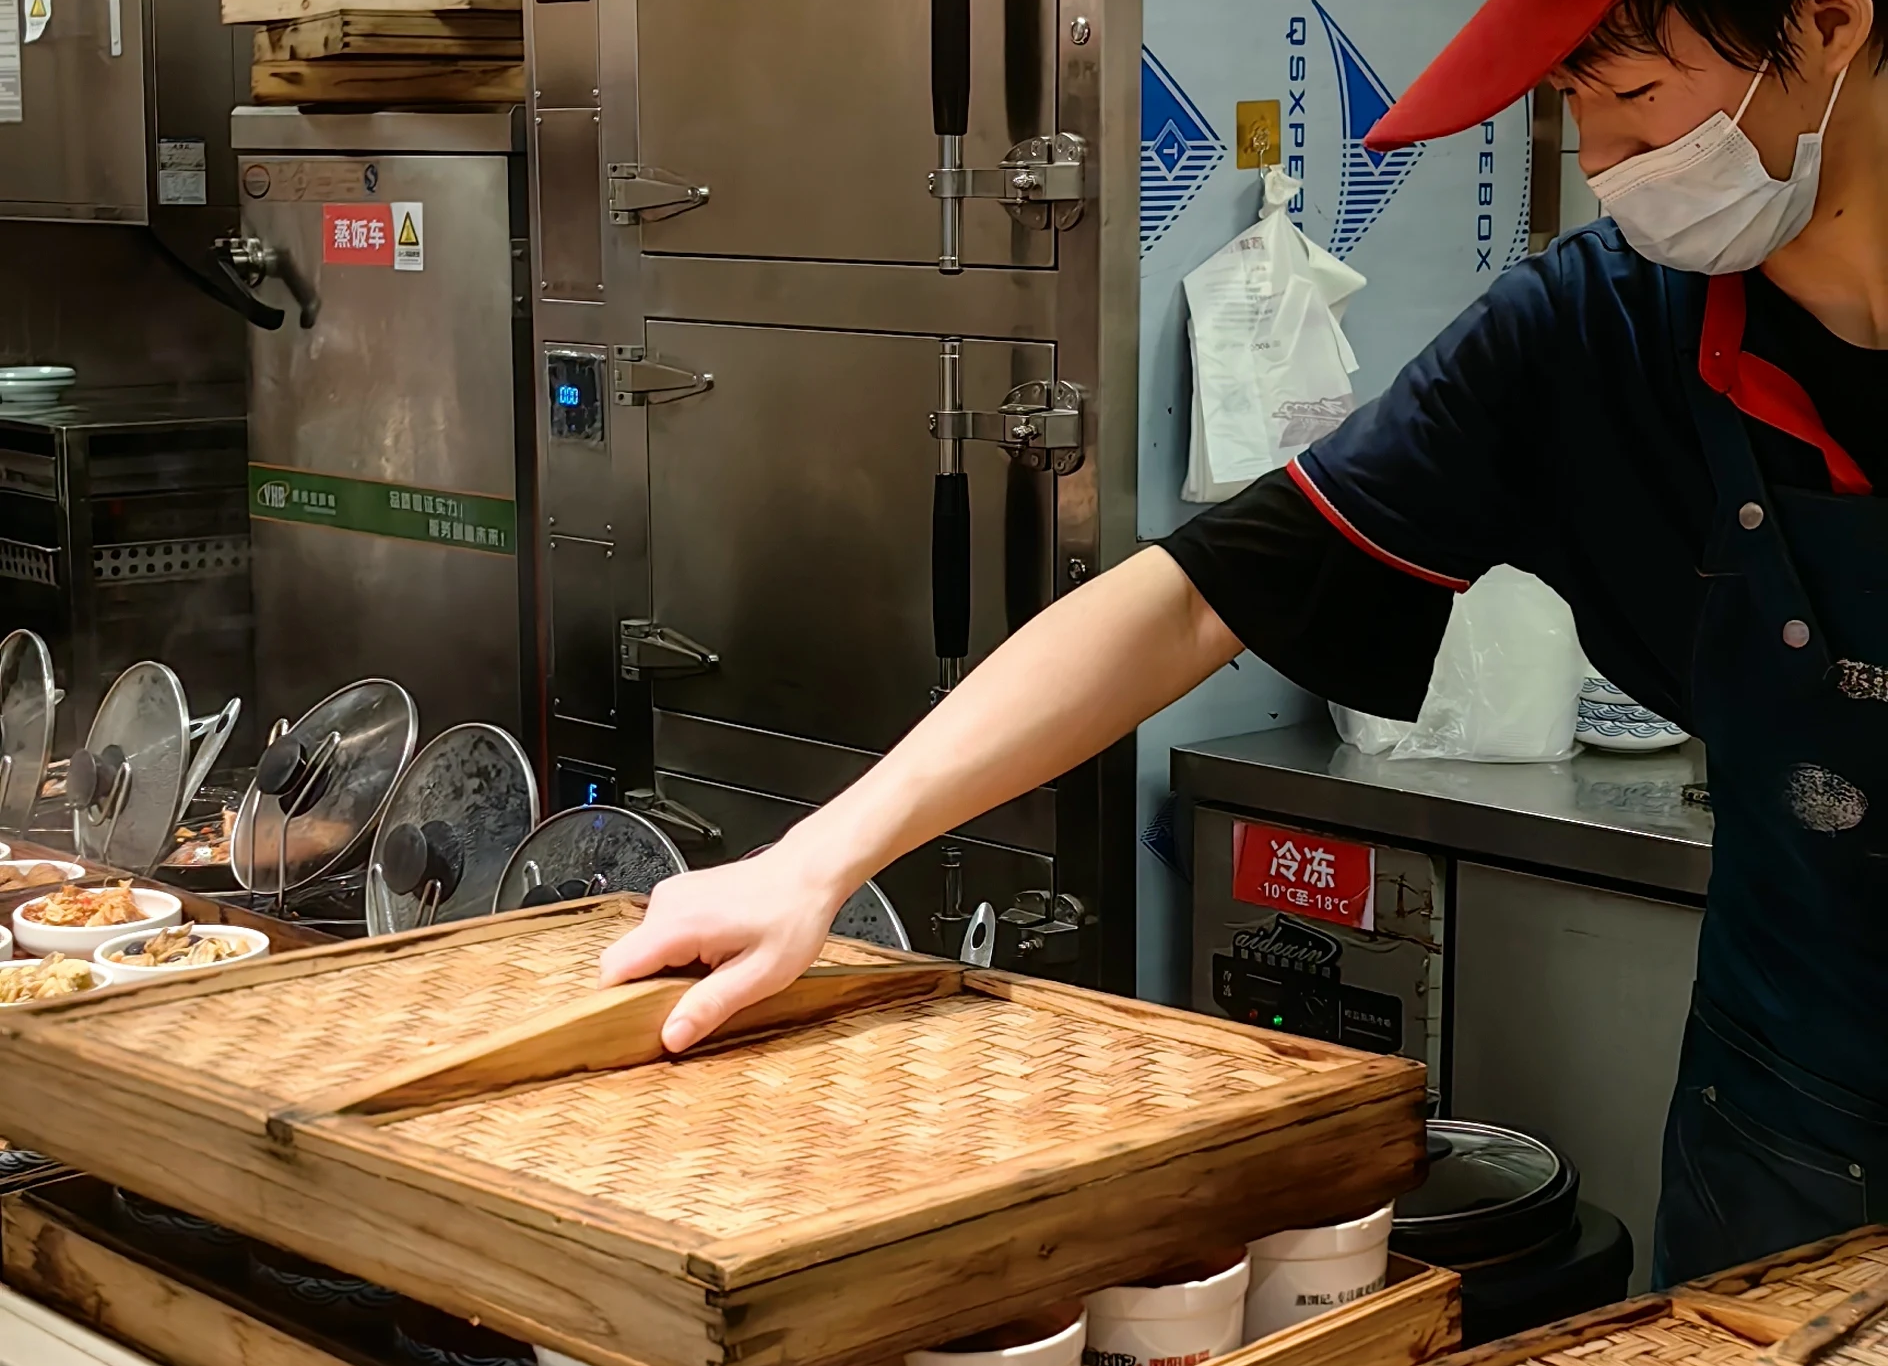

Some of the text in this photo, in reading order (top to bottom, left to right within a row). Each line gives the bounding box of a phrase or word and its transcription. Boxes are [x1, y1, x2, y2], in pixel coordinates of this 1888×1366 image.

[334, 219, 385, 249] 蒸饭车
[1270, 840, 1335, 888] 冷冻
